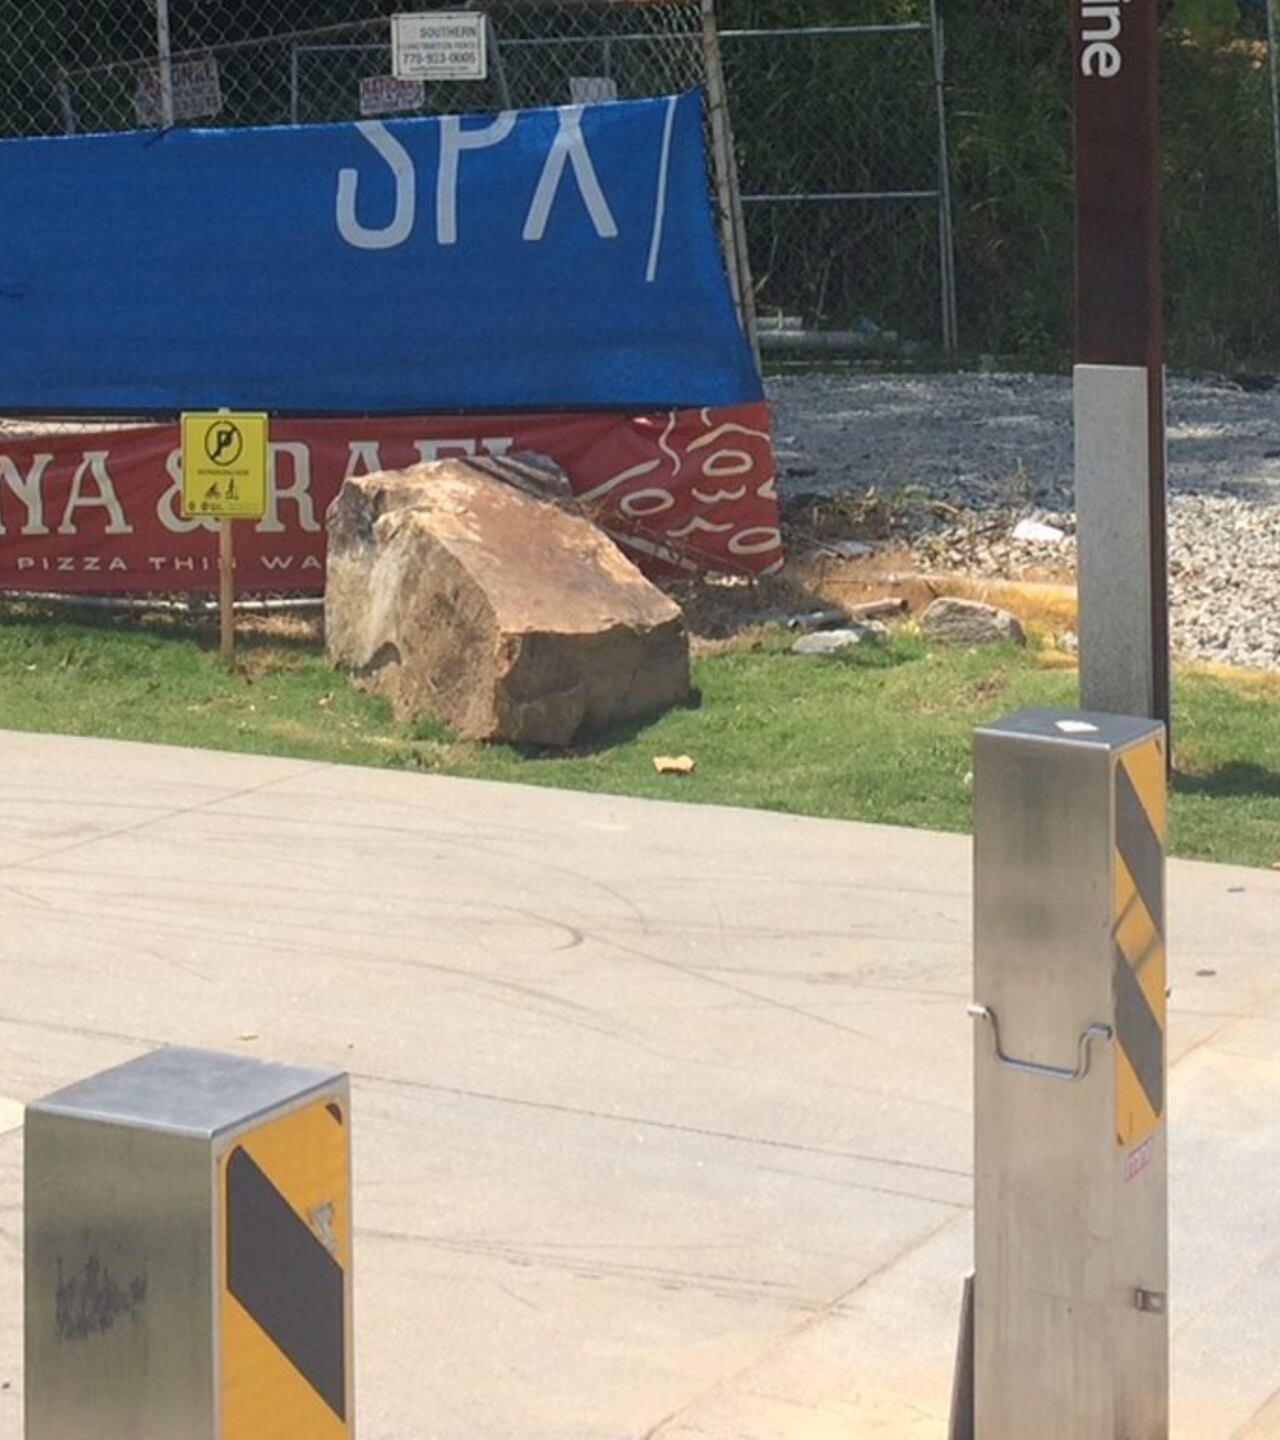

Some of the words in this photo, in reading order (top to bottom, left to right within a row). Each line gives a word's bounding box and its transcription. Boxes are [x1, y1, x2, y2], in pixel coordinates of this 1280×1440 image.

[419, 25, 477, 39] SOUTHERN
[335, 105, 619, 250] SPX
[17, 556, 129, 571] PIZZA
[148, 556, 238, 571] THI
[260, 555, 321, 571] WA
